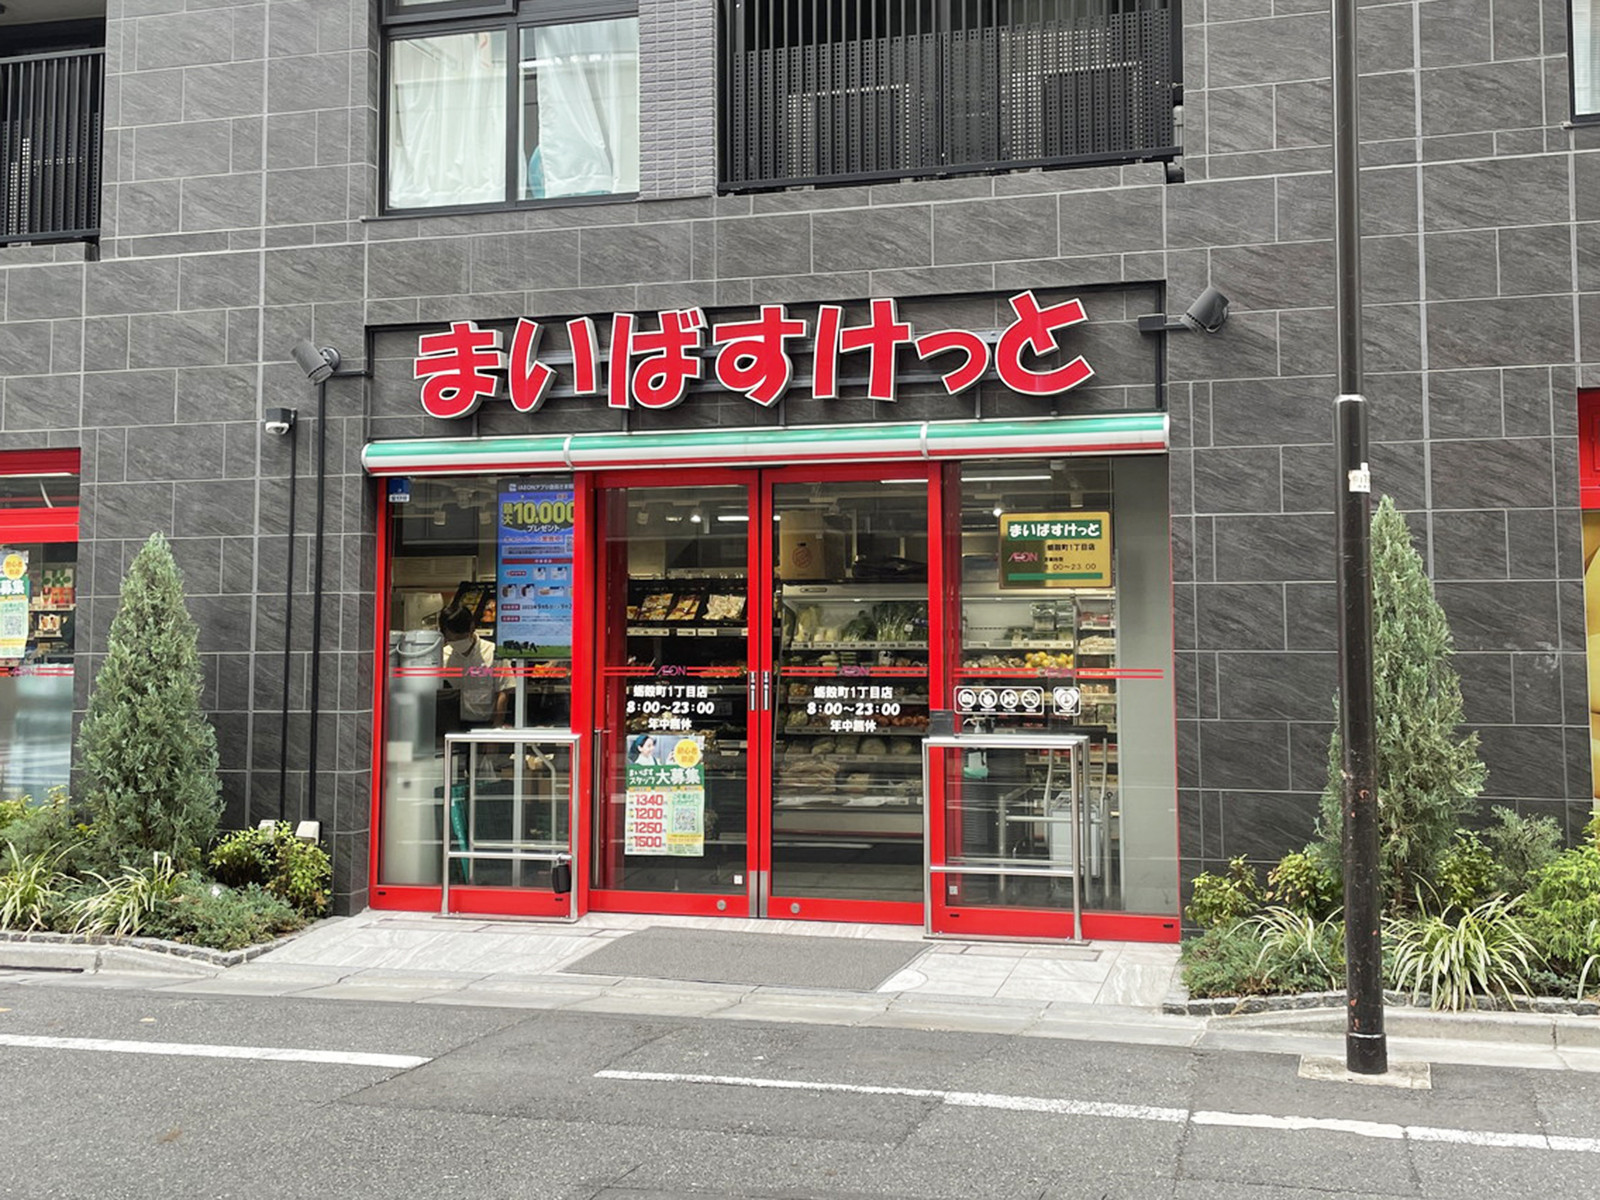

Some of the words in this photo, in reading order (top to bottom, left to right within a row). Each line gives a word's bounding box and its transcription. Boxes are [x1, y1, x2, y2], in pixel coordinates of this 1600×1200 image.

[413, 290, 1095, 419] まいばすけっと
[1009, 523, 1100, 537] まいばすけっと
[656, 665, 686, 676] AEON
[648, 717, 692, 730] 年中無休
[830, 719, 877, 732] 年中無休
[655, 768, 700, 785] 大募集
[635, 794, 663, 806] 1340
[635, 808, 663, 819] 1200
[634, 822, 662, 833] 1250
[633, 836, 662, 847] 1500
